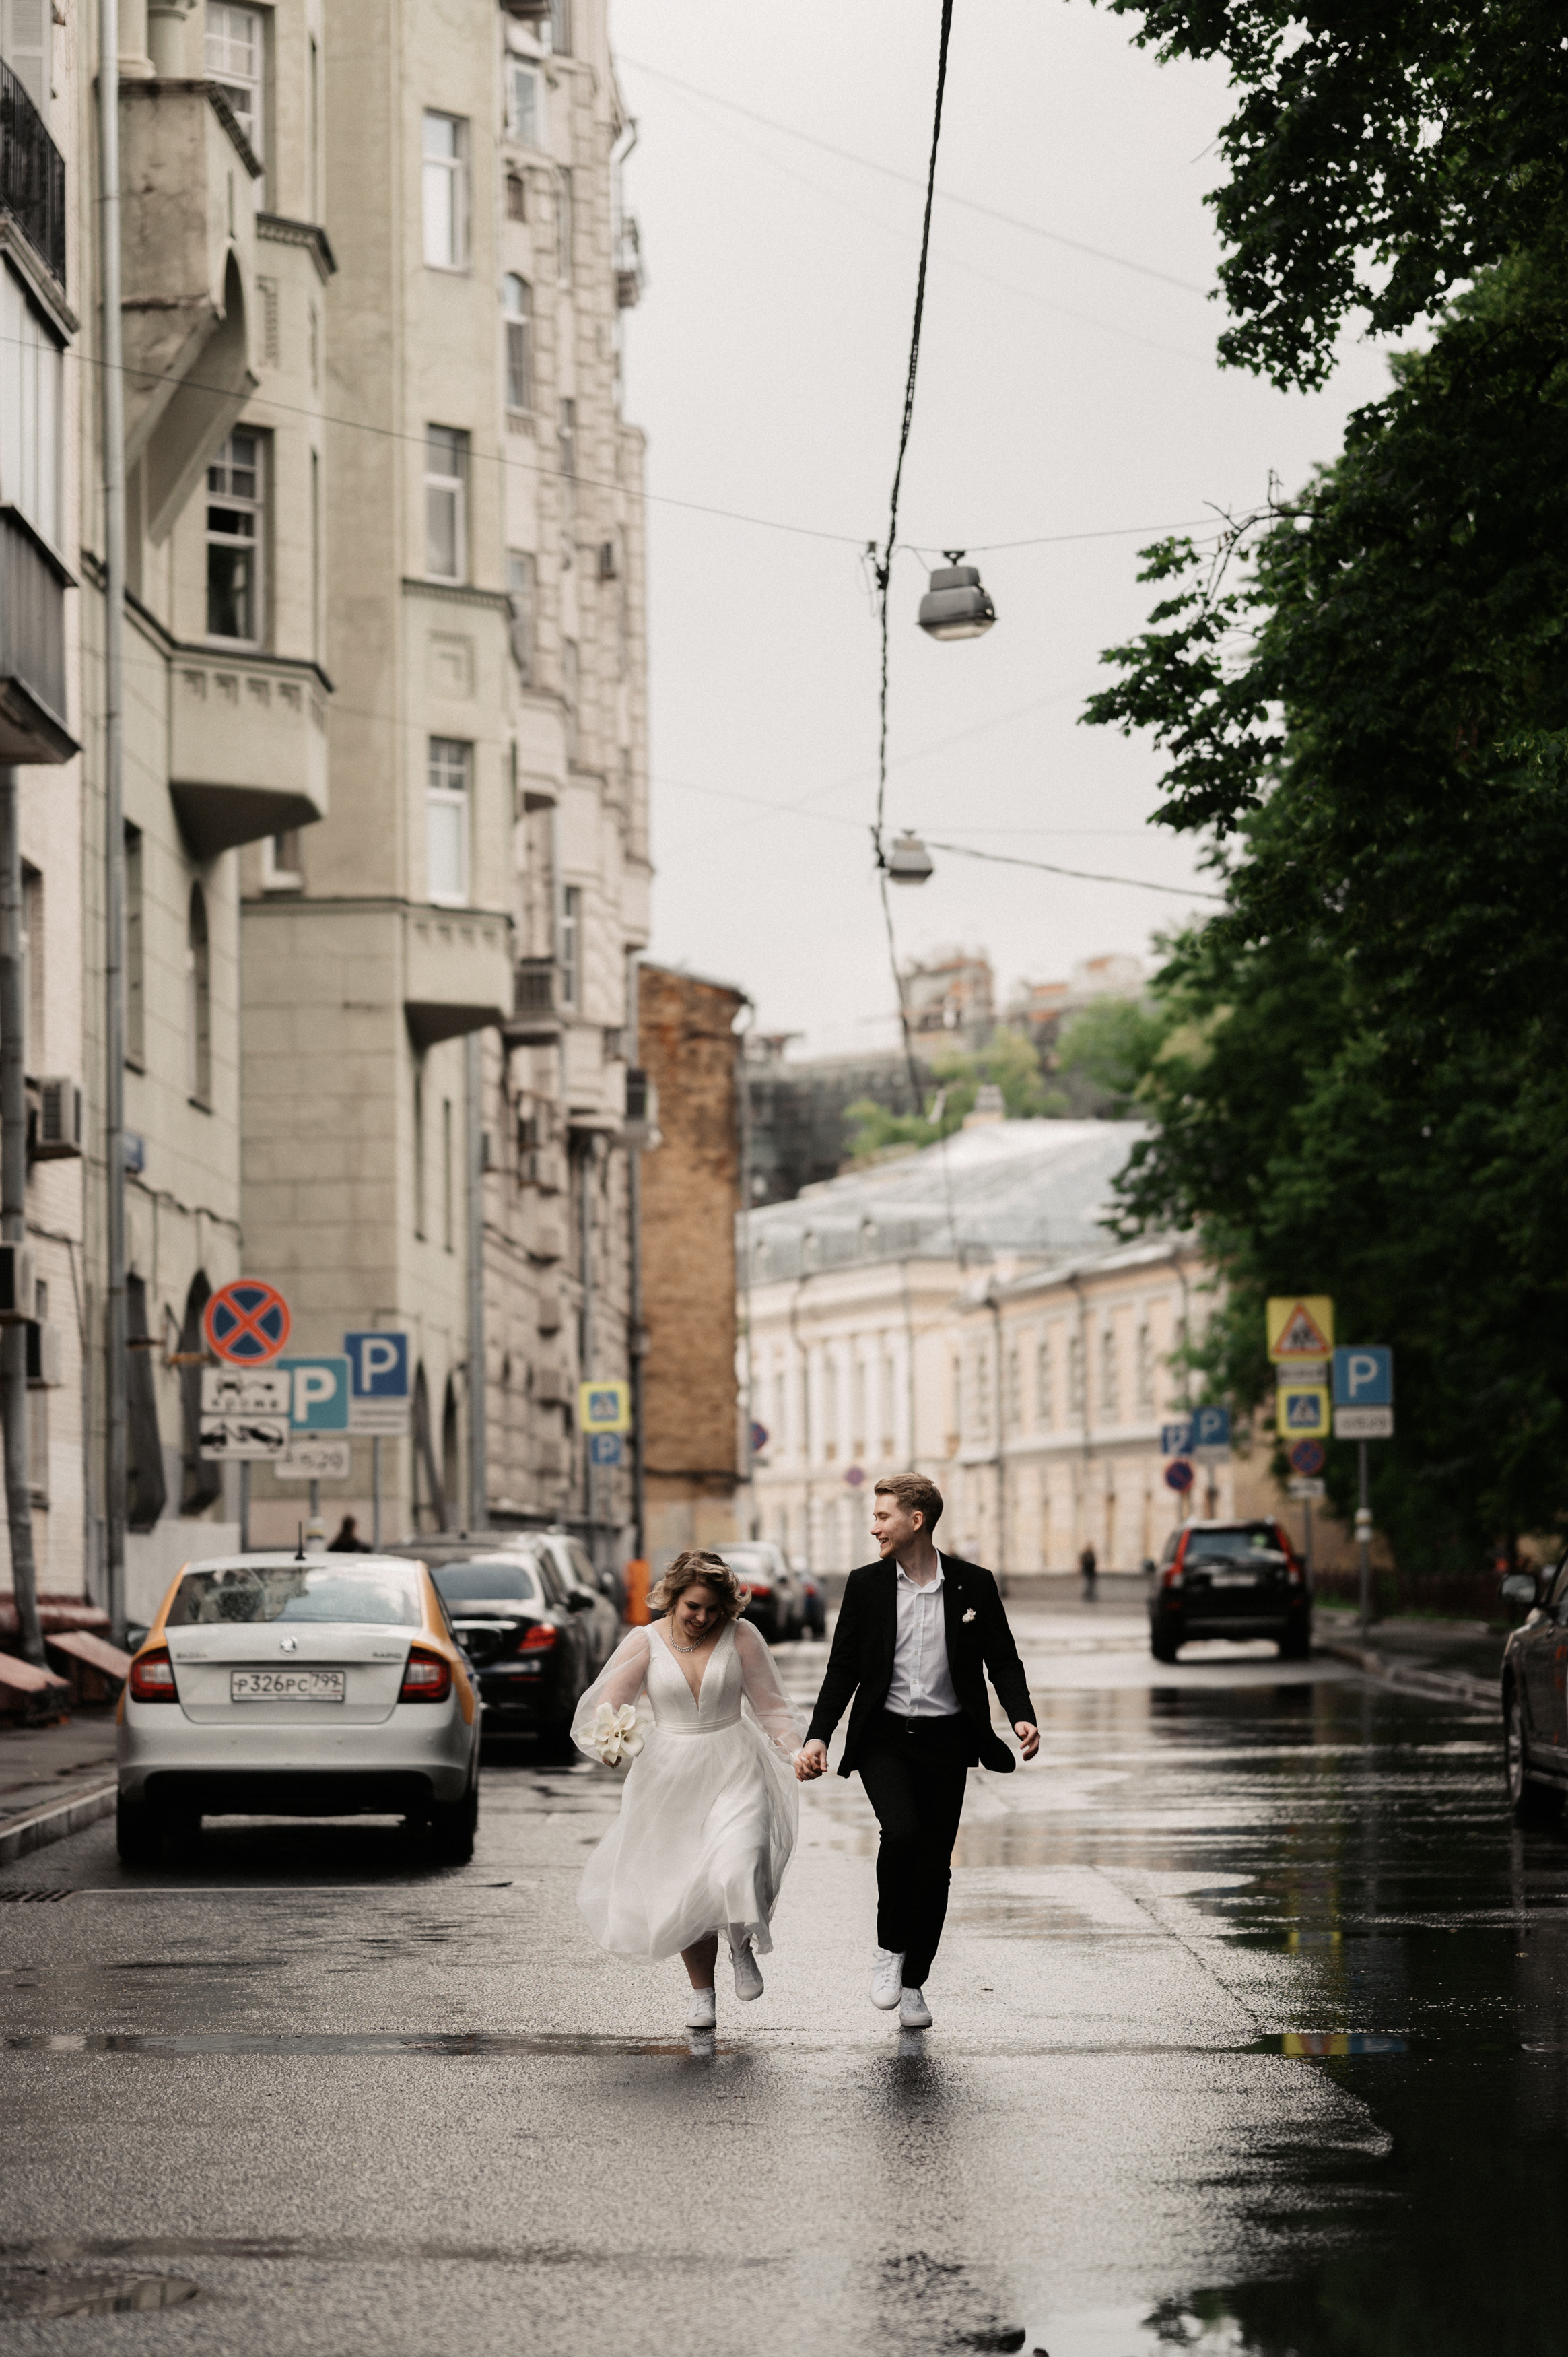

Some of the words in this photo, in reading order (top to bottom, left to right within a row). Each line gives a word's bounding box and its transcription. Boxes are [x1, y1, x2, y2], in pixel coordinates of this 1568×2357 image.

[361, 1338, 399, 1392] P
[1349, 1355, 1378, 1398] P
[293, 1366, 337, 1423] P
[312, 1673, 339, 1687] 799
